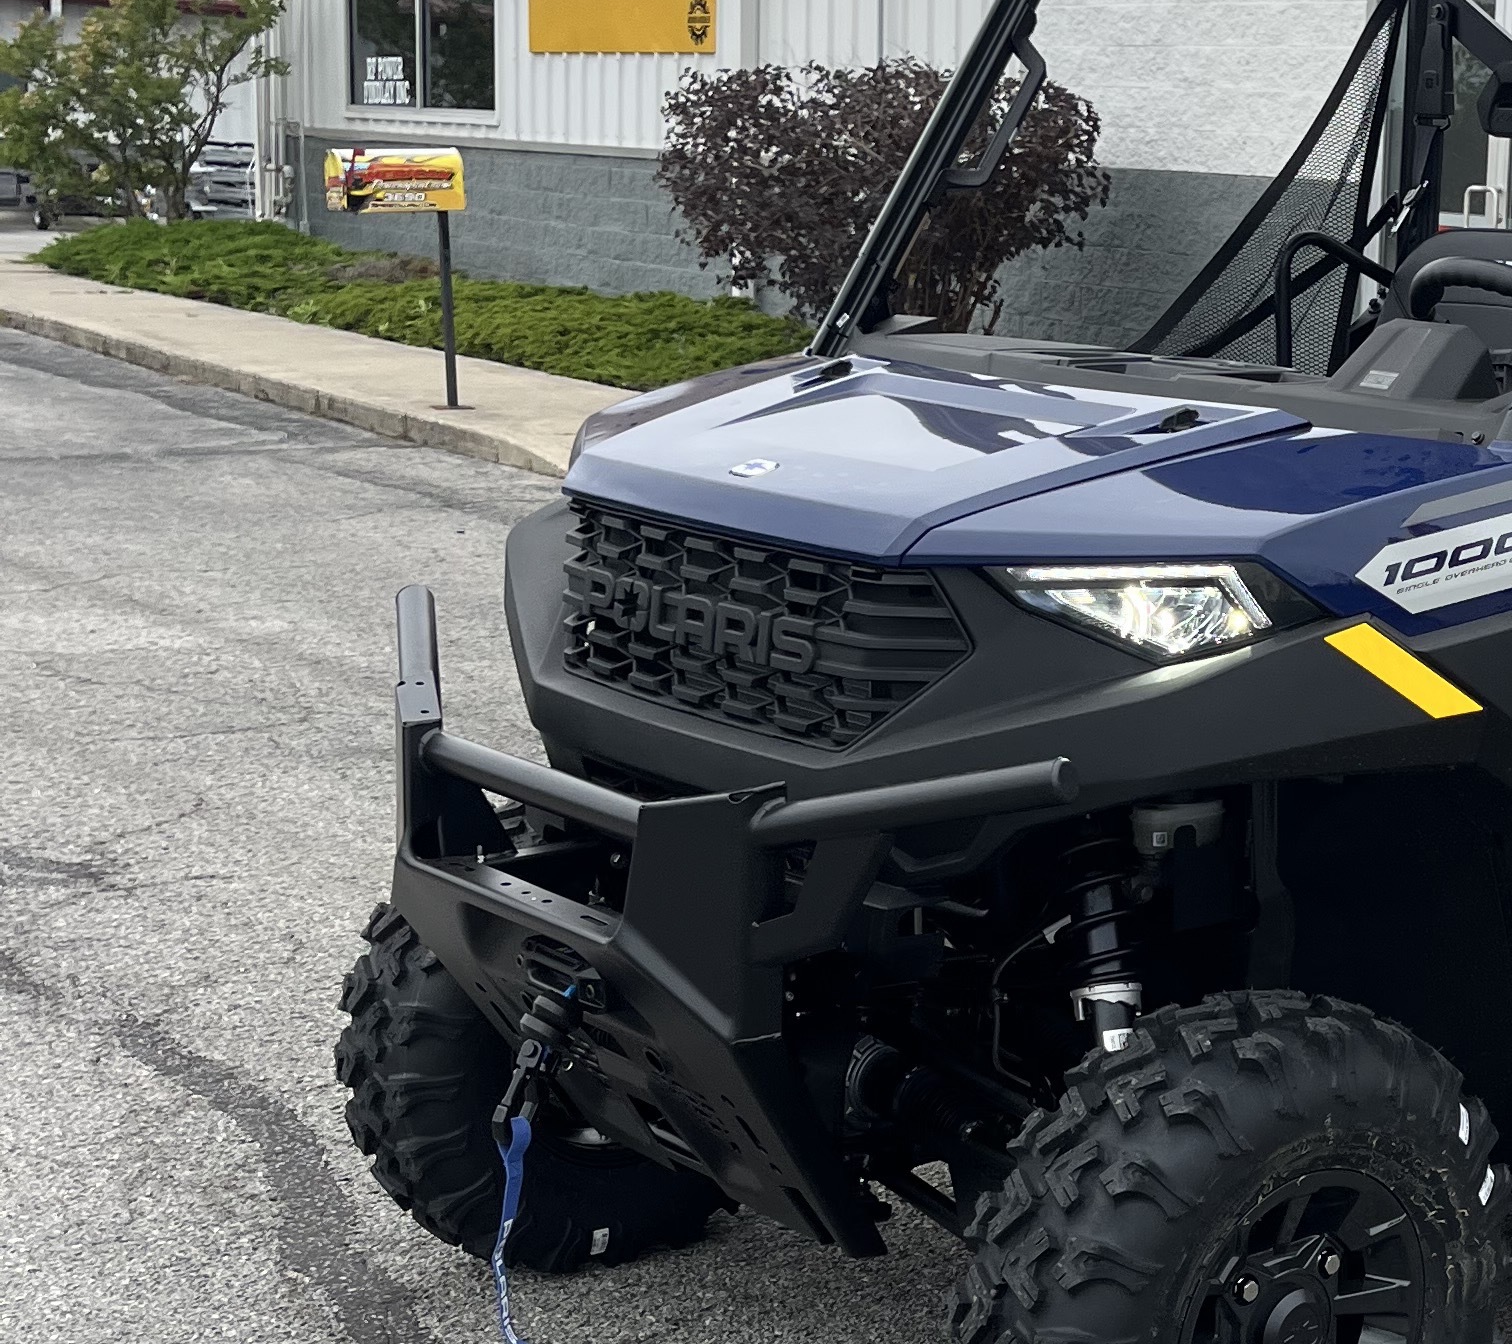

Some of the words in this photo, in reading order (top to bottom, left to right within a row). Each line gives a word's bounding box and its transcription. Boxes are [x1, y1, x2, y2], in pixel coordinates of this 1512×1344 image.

[1396, 577, 1440, 595] SINGLE
[1444, 559, 1507, 582] OVERHEAD
[583, 564, 819, 674] POLARIS
